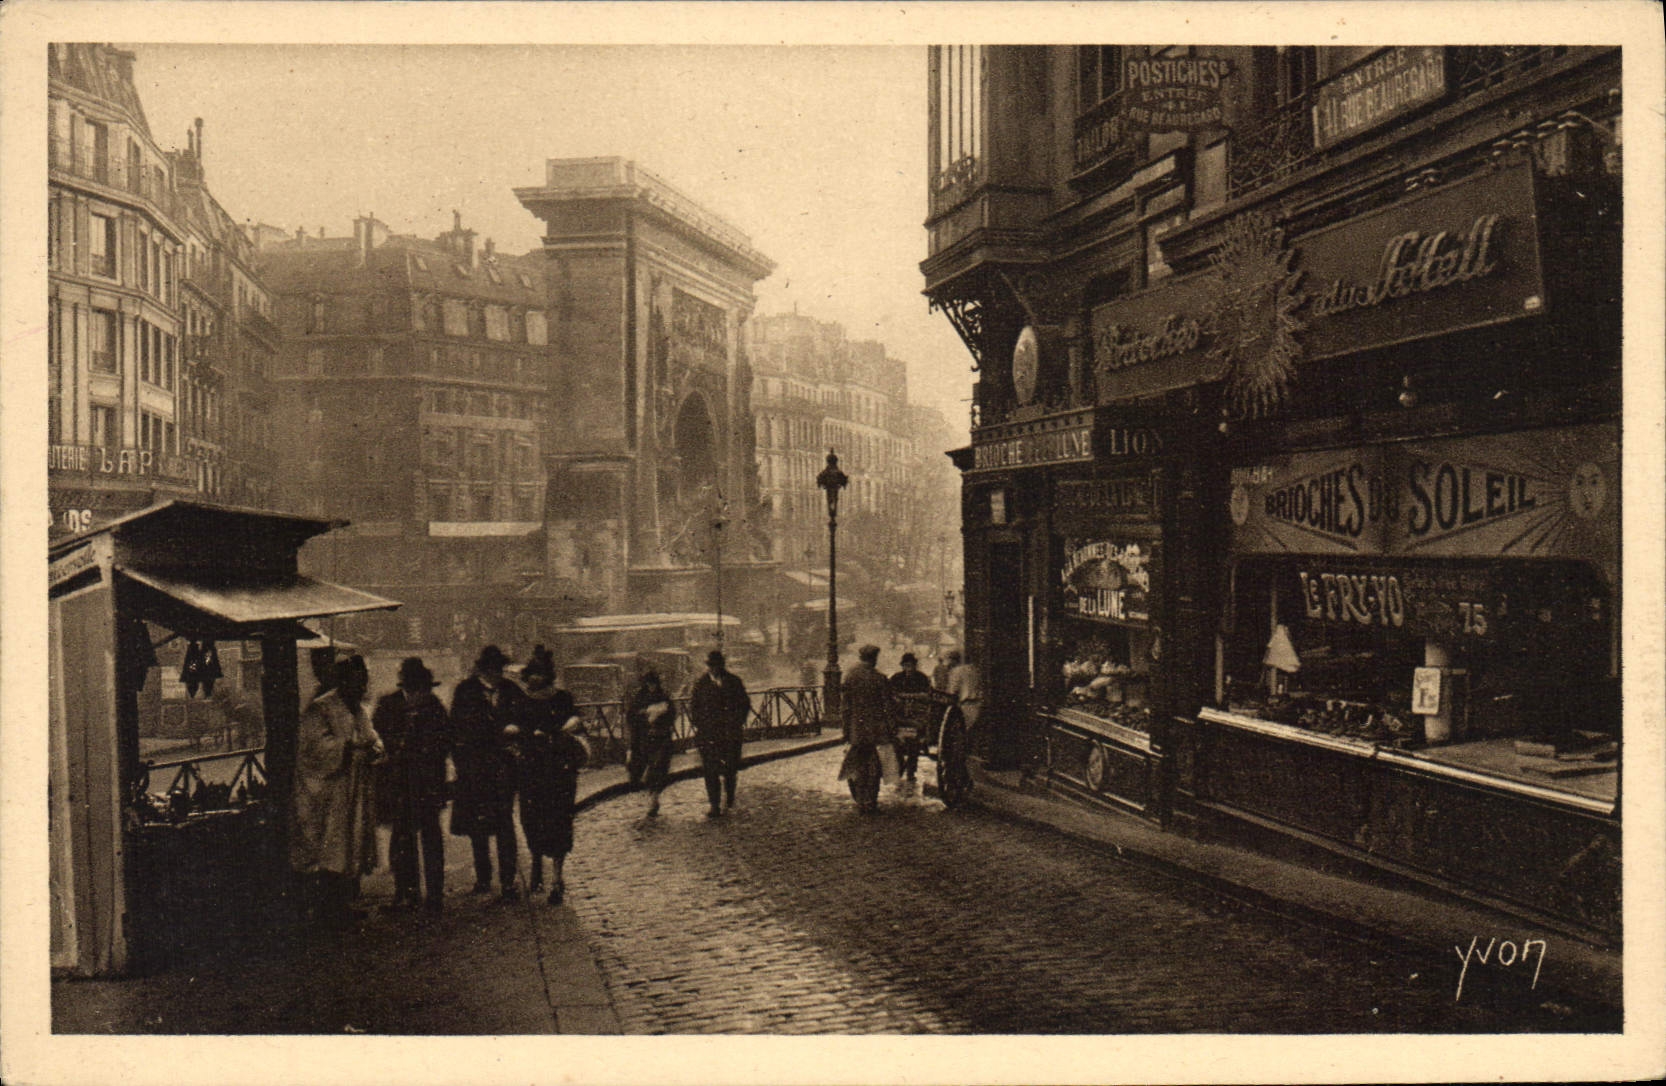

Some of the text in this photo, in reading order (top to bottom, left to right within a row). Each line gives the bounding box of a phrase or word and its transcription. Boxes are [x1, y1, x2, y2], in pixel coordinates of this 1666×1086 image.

[1127, 60, 1219, 88] POSTICHES
[1340, 91, 1363, 131] RUE
[1366, 54, 1445, 121] BEAUREGARD
[1265, 463, 1364, 537] BRIOCHES
[1408, 461, 1537, 536] SOLEIL
